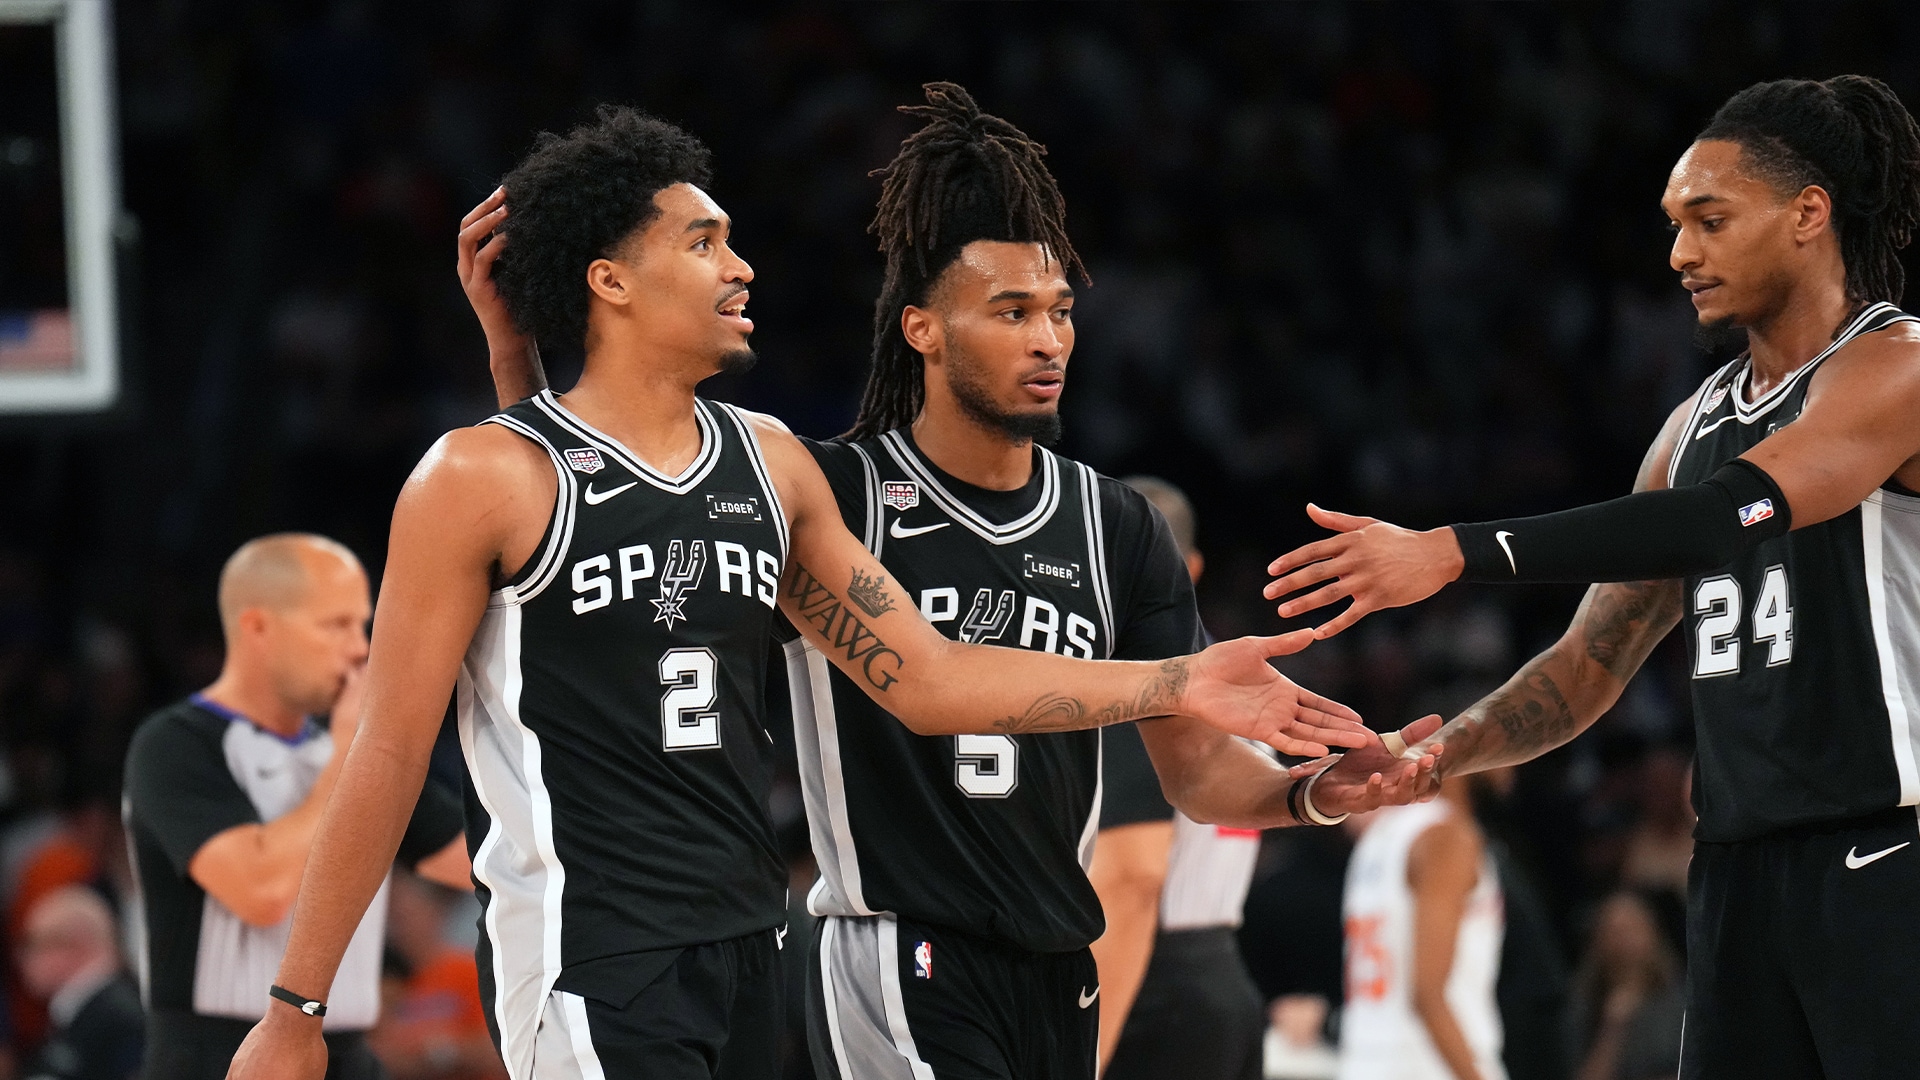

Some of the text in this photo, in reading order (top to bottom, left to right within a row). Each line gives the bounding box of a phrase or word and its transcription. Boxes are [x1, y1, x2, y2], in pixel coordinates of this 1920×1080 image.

[573, 461, 602, 470] 250
[714, 501, 754, 514] LEDGER
[886, 496, 916, 504] 250
[572, 540, 779, 632] SPURS
[1031, 561, 1073, 580] LEDGER
[788, 562, 904, 692] WAWG
[1692, 563, 1794, 680] 24
[658, 647, 721, 752] 2
[954, 734, 1019, 798] 5
